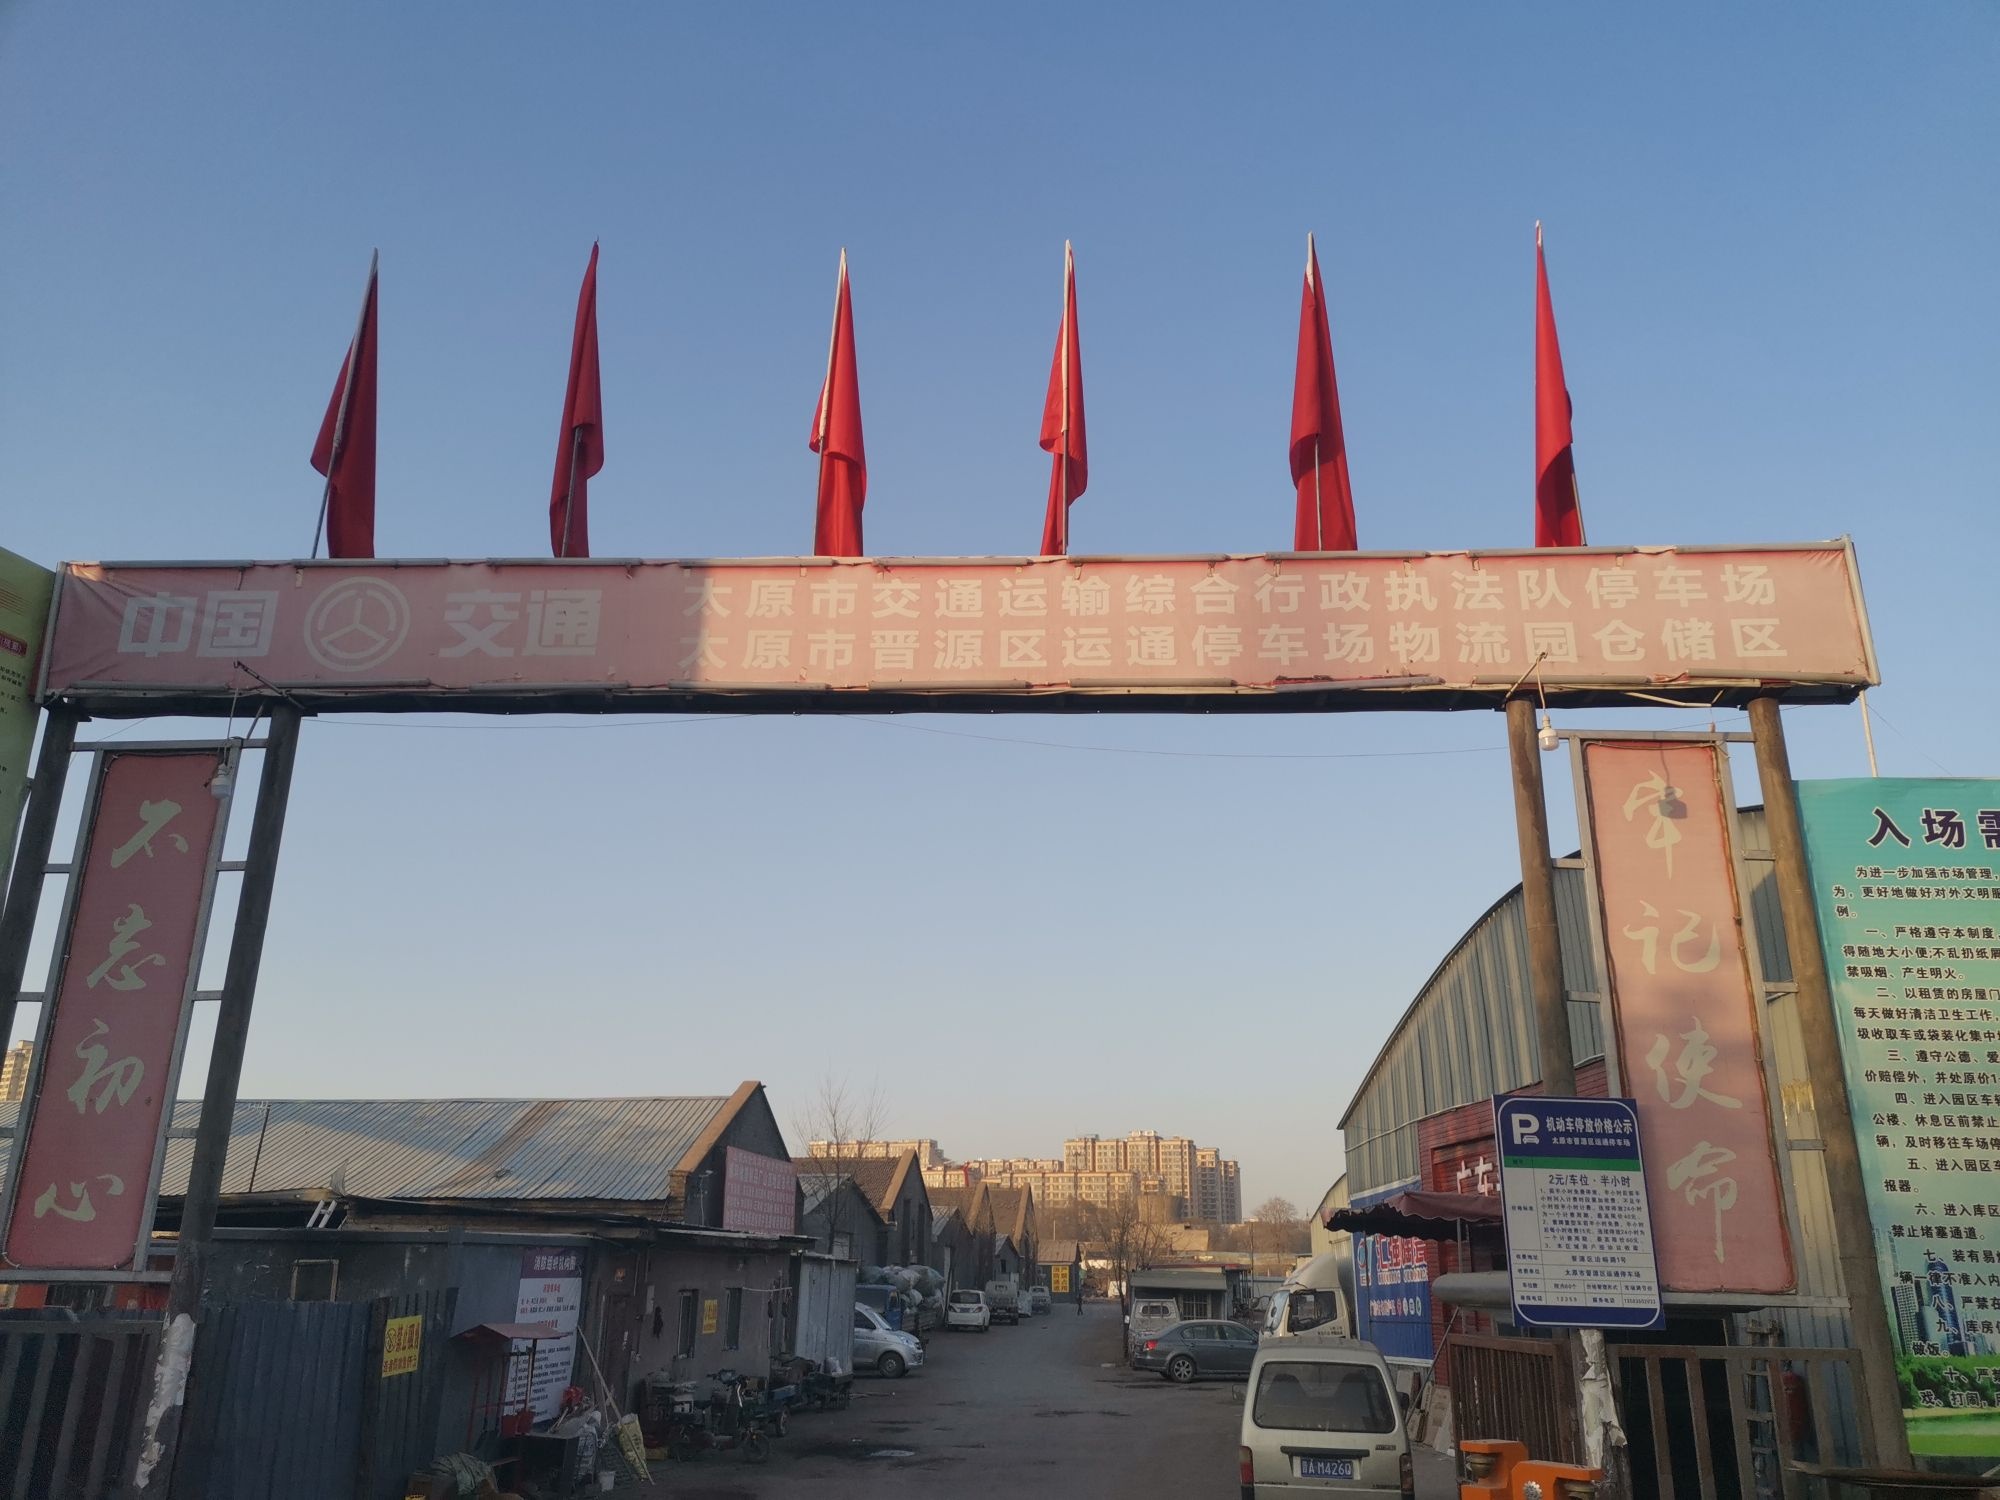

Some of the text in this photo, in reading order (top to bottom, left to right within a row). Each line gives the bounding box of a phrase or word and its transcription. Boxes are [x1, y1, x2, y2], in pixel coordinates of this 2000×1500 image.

[684, 564, 1777, 620] 太原市交通运输综合行政执法队停车场
[117, 590, 279, 658] 中国
[438, 588, 603, 658] 交通
[679, 617, 1788, 671] 太原市晋源区运通停车场物流园仓储区
[1846, 965, 1964, 980] 禁吸烟、产生明火。
[34, 798, 190, 1223] 不忘初心
[1621, 768, 1743, 1265] 牢记使命
[1857, 1027, 2000, 1042] 圾收取车或袋装化集中
[1511, 1113, 1540, 1145] P
[1545, 1115, 1633, 1135] 机动车停放价格公示
[1456, 1156, 1501, 1197] 广东
[1884, 1178, 1920, 1193] 报器。
[1891, 1224, 1986, 1240] 禁止堵塞通道。
[1923, 1248, 2000, 1264] 七、装有易
